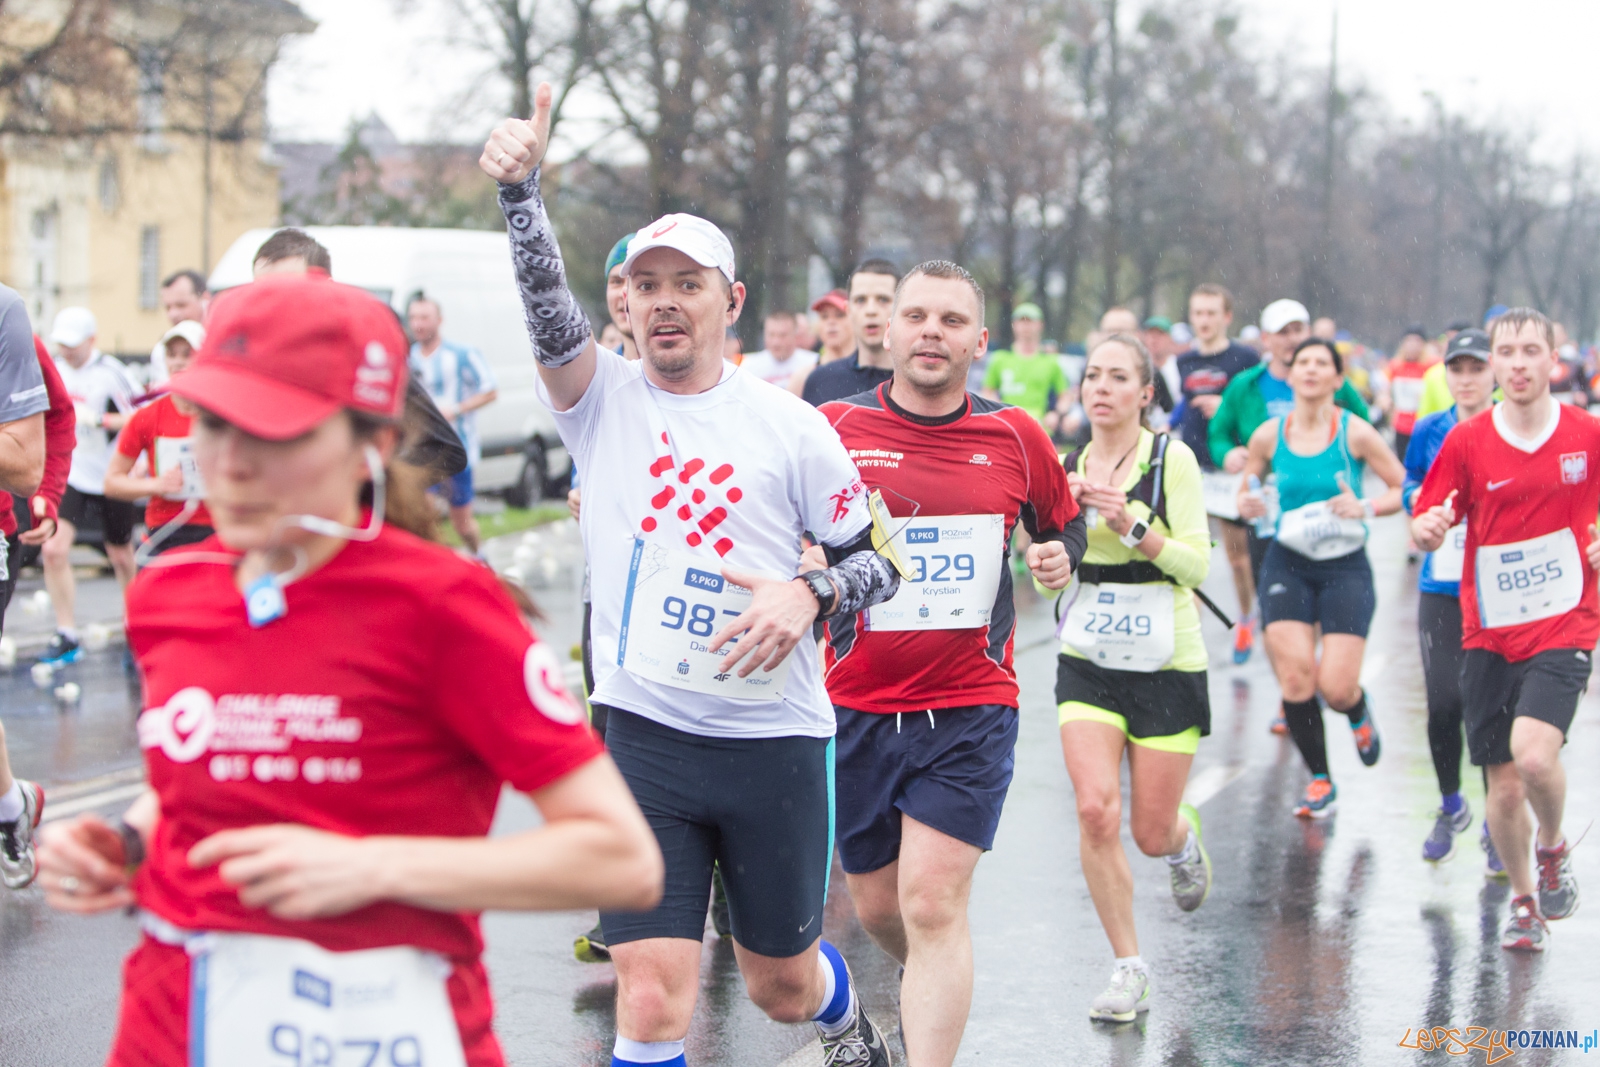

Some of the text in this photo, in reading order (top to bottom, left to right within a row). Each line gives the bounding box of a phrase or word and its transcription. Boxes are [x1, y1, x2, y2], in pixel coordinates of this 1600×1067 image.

[856, 460, 899, 469] KRYSTIAN
[1497, 559, 1563, 592] 8855
[922, 586, 961, 597] Krystian
[950, 608, 965, 617] 4F
[1084, 611, 1151, 636] 2249
[713, 673, 732, 683] 4F
